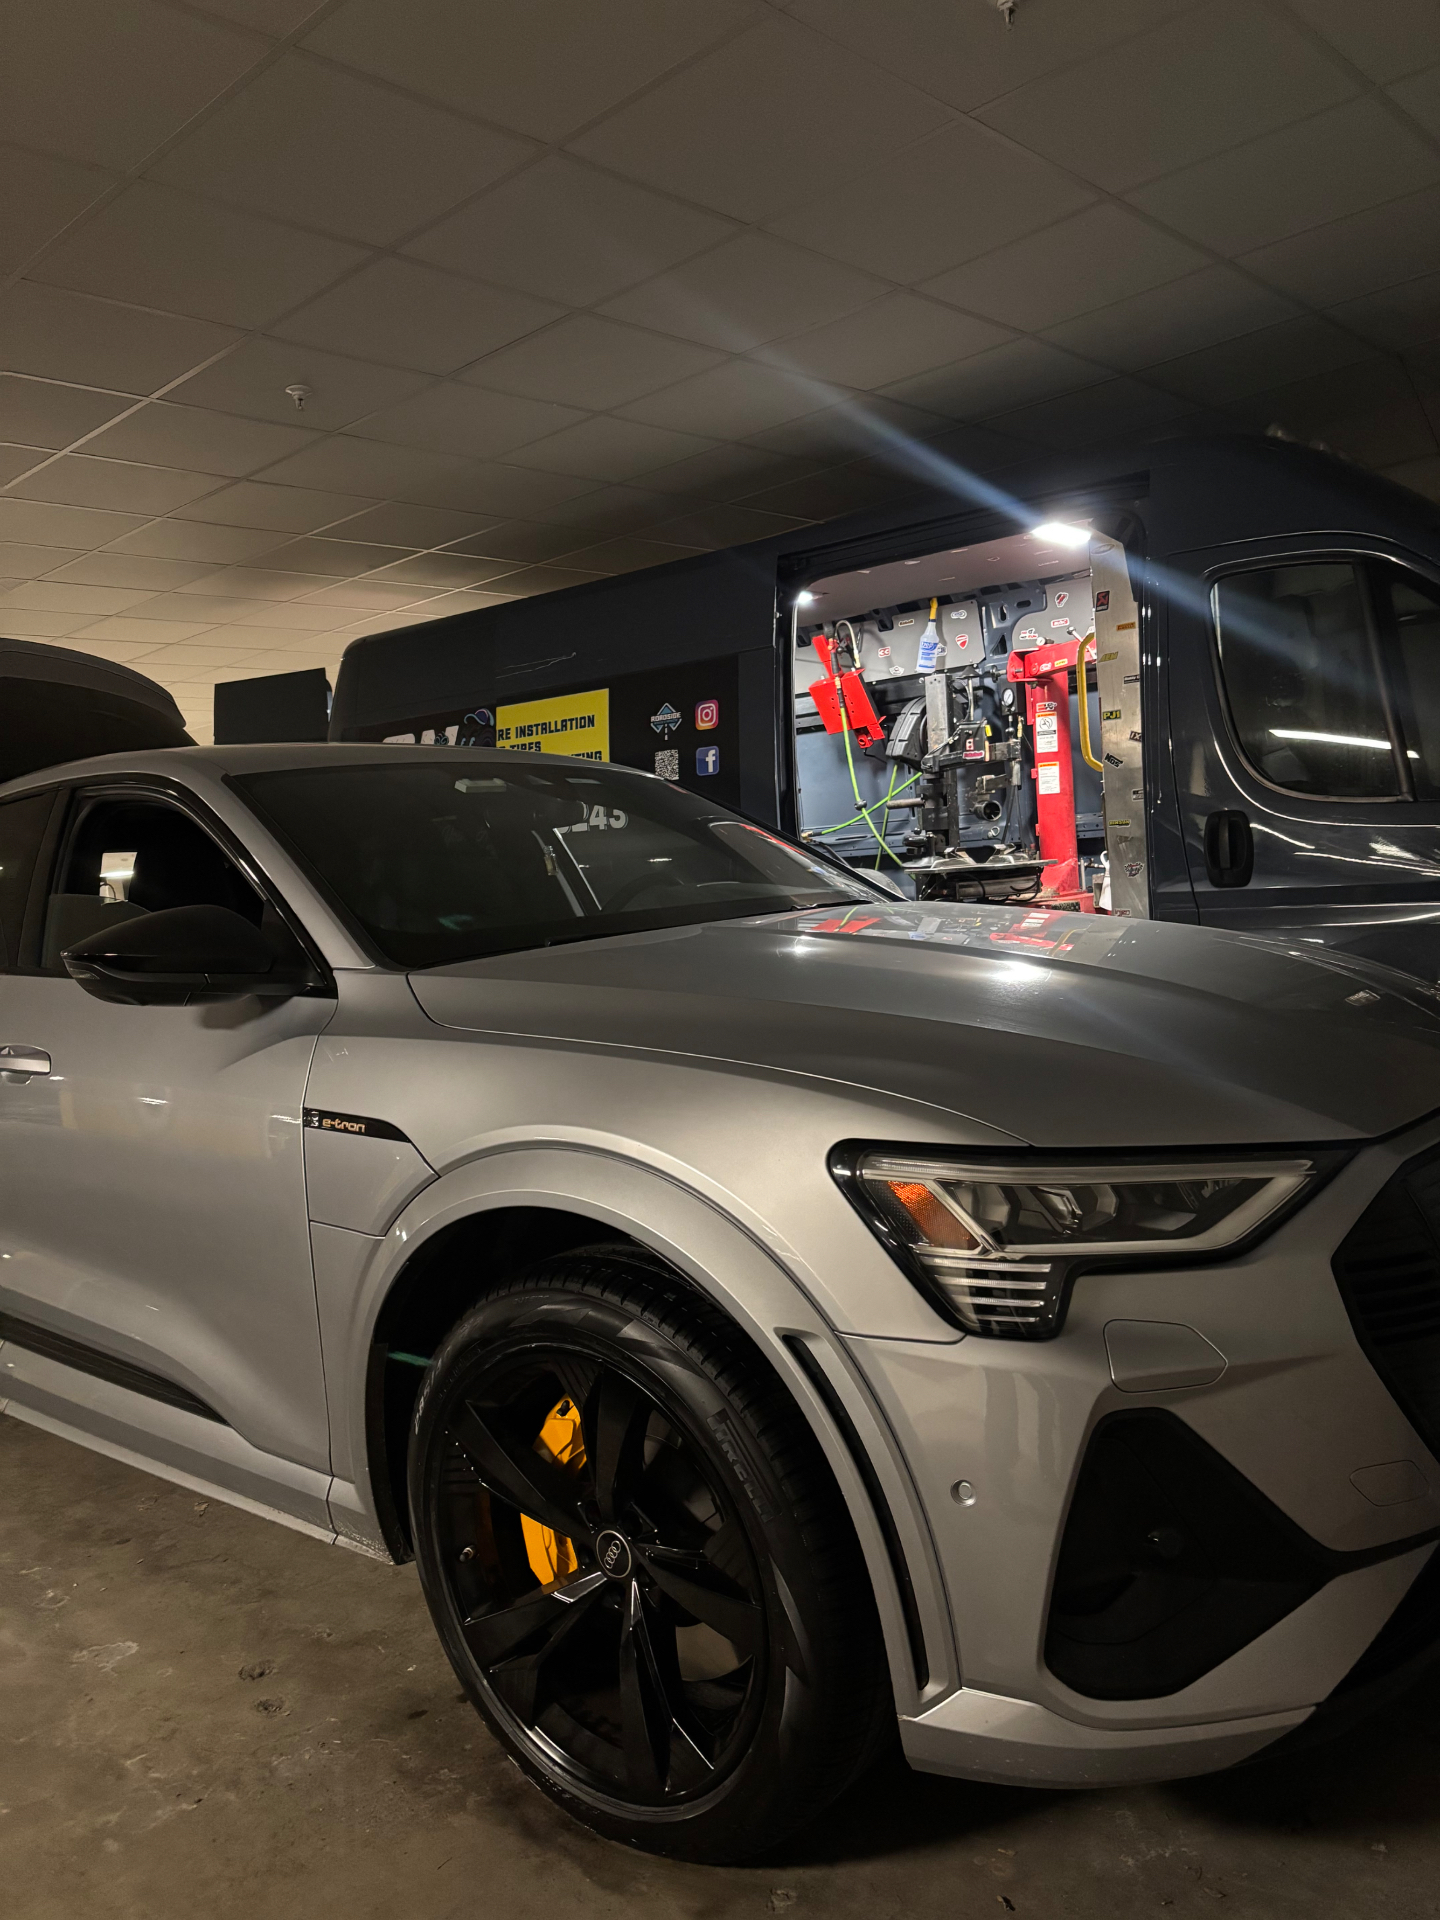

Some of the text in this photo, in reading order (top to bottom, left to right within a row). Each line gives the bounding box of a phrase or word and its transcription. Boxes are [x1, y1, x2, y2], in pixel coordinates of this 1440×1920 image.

[650, 711, 682, 723] ROADSIDE
[1103, 711, 1120, 720] PJ1
[497, 714, 595, 742] RE INSTALLATION
[1104, 753, 1123, 768] NOS
[322, 1118, 366, 1134] e-tron
